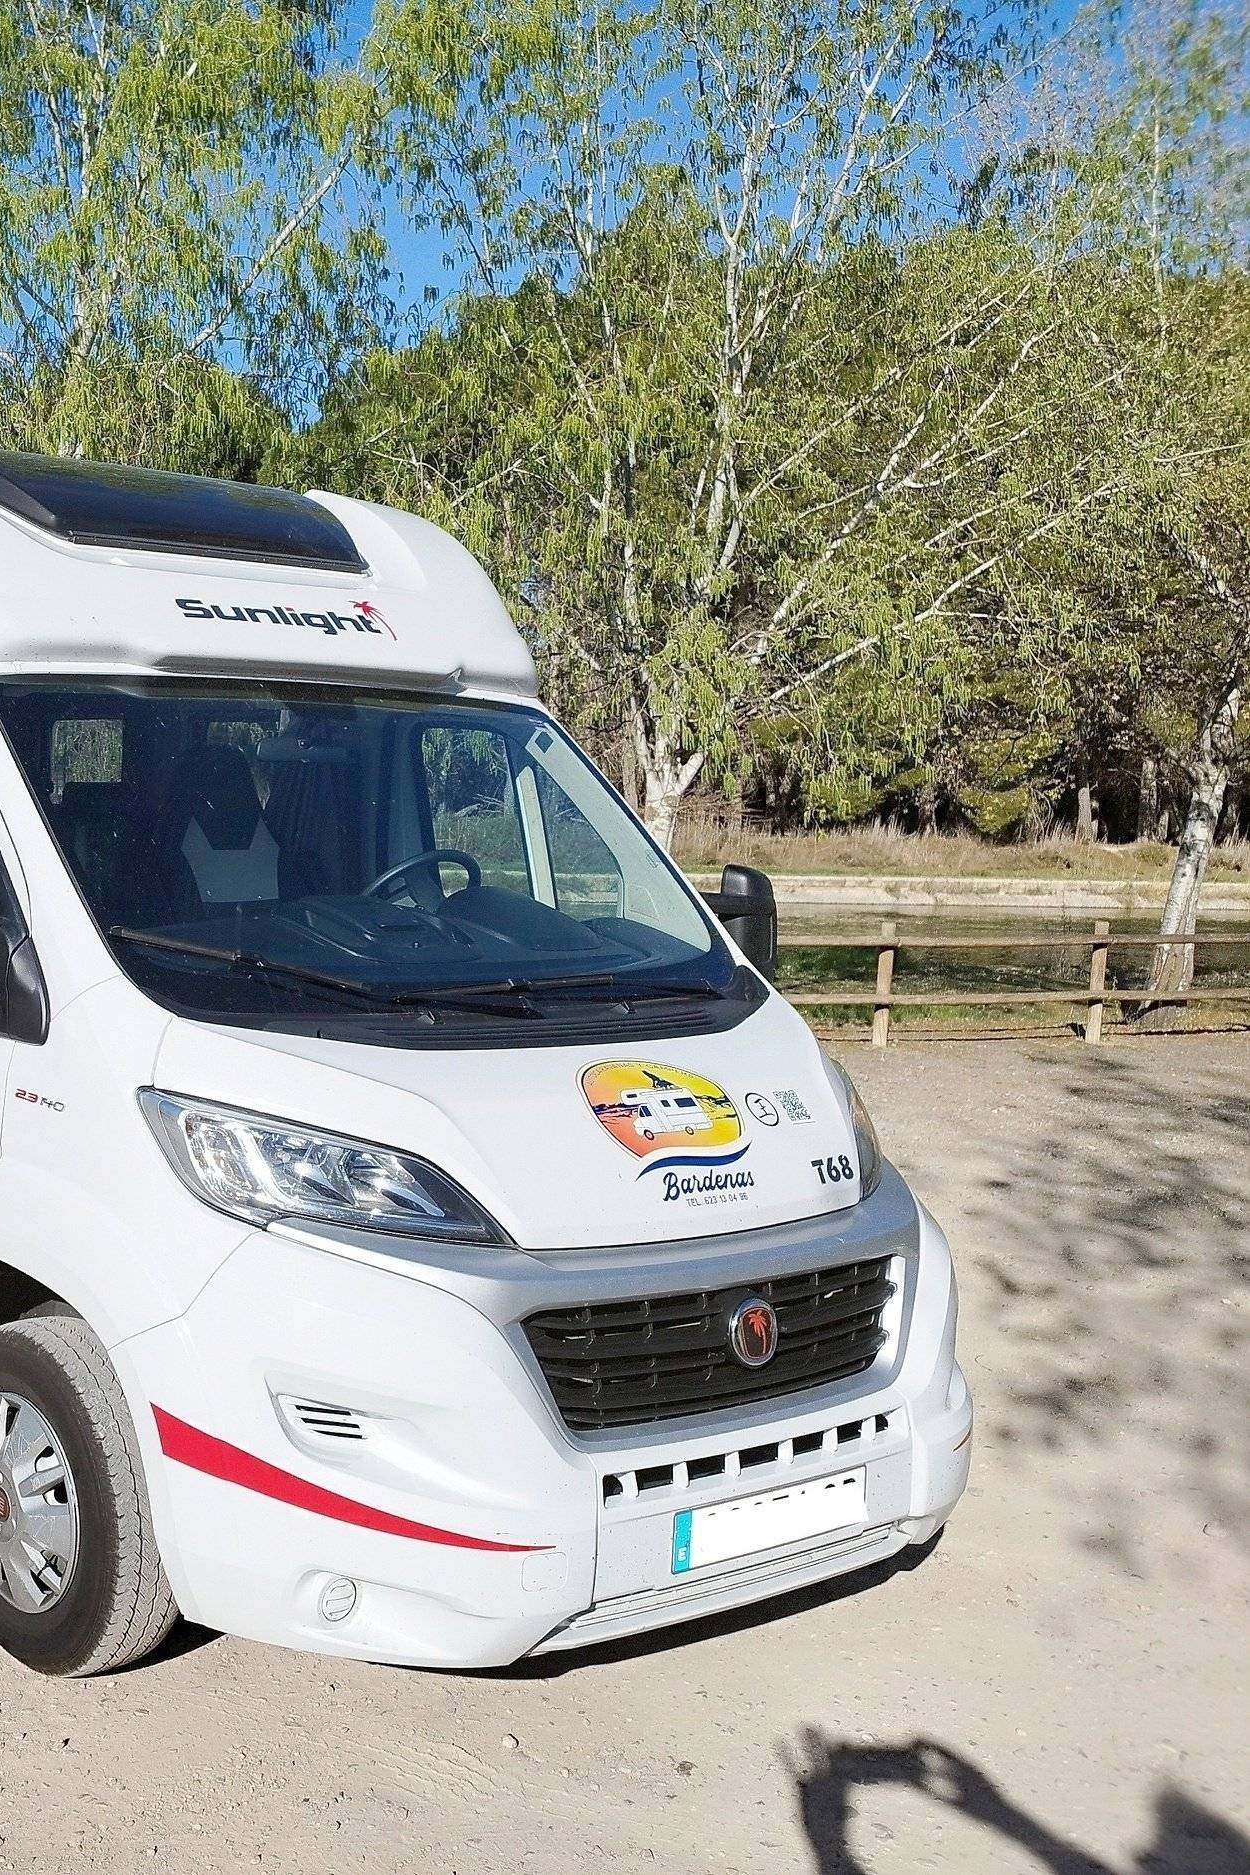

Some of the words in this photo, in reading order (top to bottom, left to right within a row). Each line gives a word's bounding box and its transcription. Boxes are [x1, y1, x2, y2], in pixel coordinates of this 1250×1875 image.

[175, 598, 382, 635] Sunlight
[662, 1168, 755, 1202] Bardenas
[811, 1154, 854, 1184] T68
